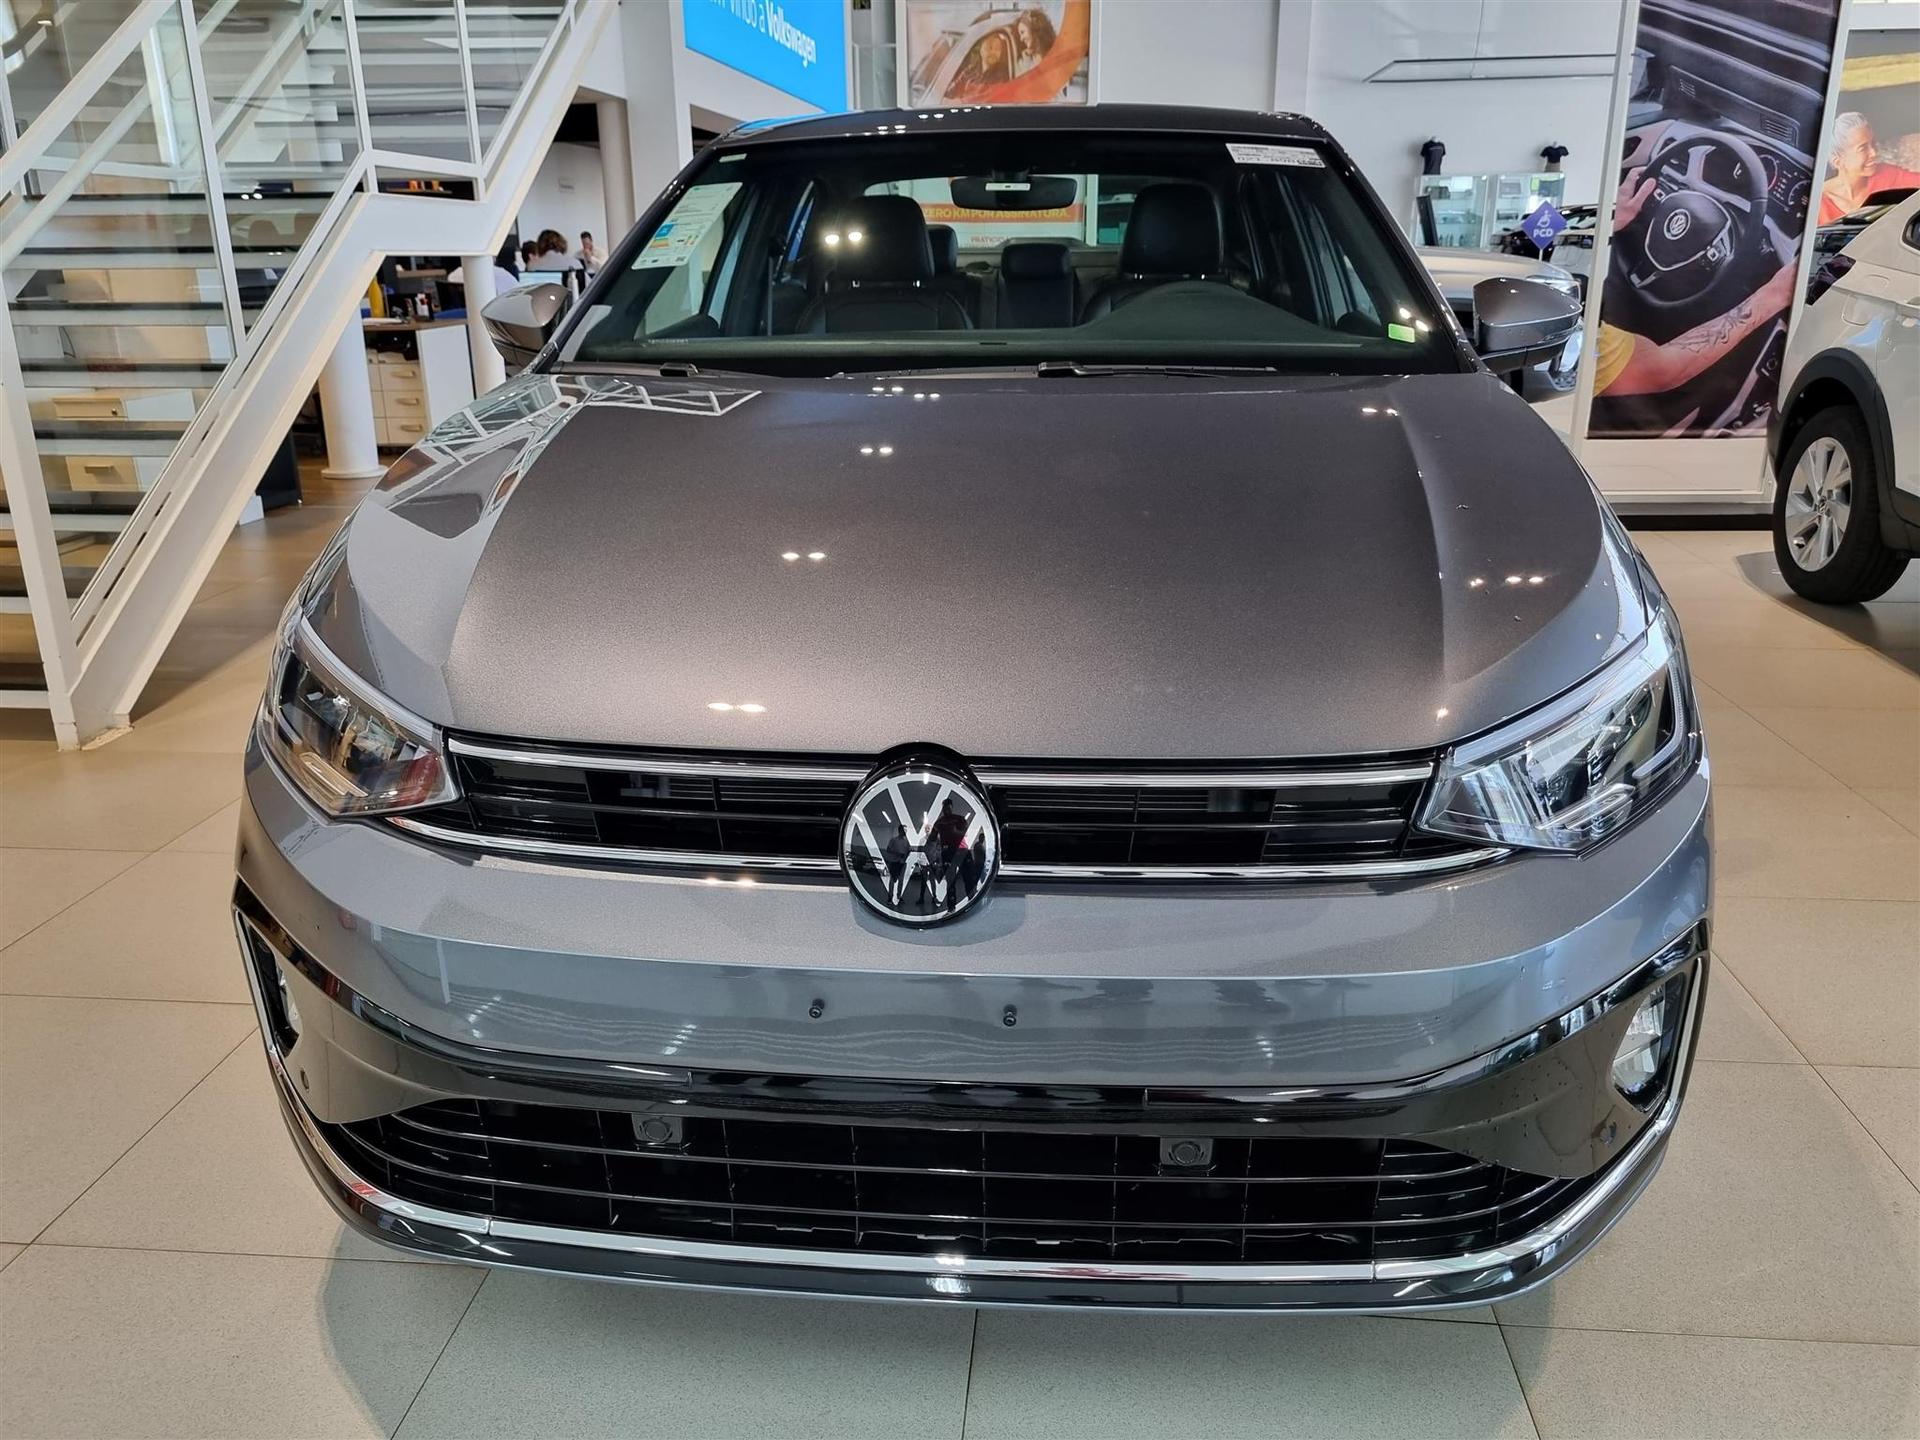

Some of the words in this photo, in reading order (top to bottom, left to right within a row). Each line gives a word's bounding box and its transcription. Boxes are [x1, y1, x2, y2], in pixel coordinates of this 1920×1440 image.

[765, 0, 816, 68] Volkswagen
[953, 208, 970, 218] KM
[1533, 229, 1554, 238] PCD
